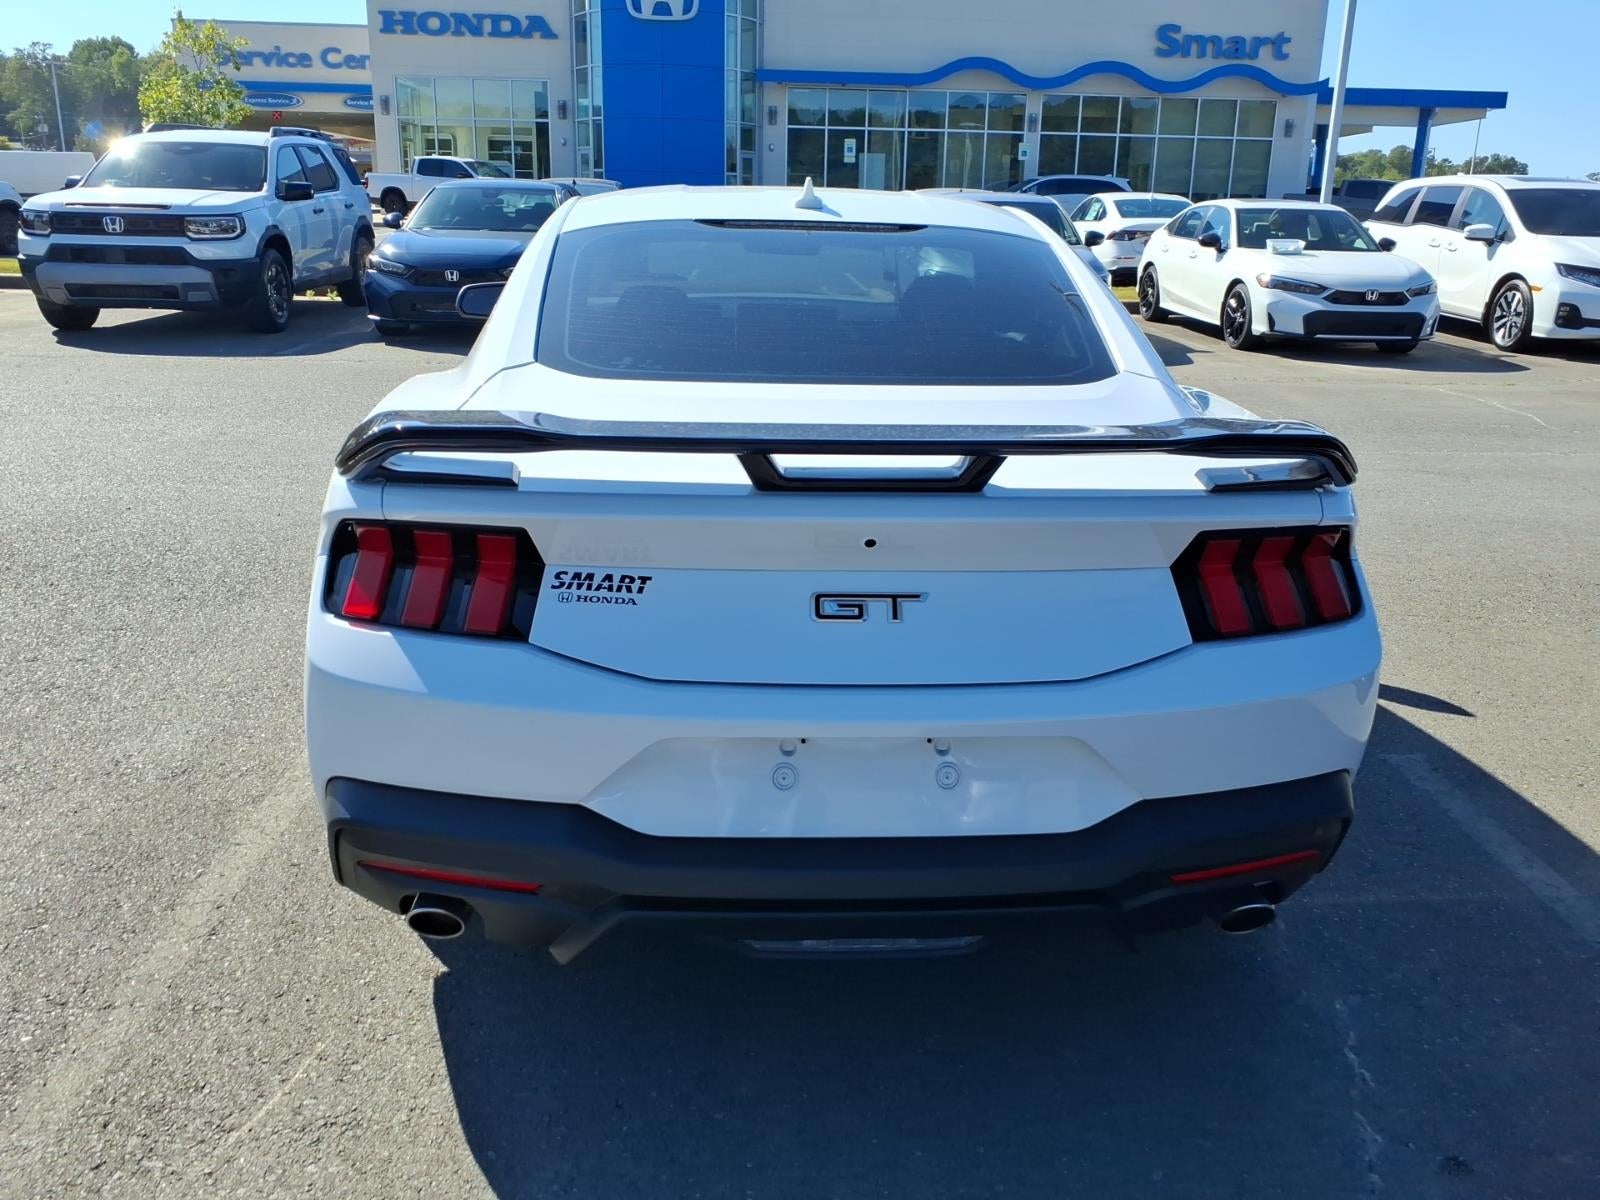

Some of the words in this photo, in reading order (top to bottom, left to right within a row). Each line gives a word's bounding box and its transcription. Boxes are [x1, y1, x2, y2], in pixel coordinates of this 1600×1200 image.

[377, 10, 559, 39] HONDA
[1154, 23, 1292, 61] Smart
[550, 570, 653, 595] SMART
[575, 594, 638, 606] HONDA
[809, 591, 930, 623] GT
